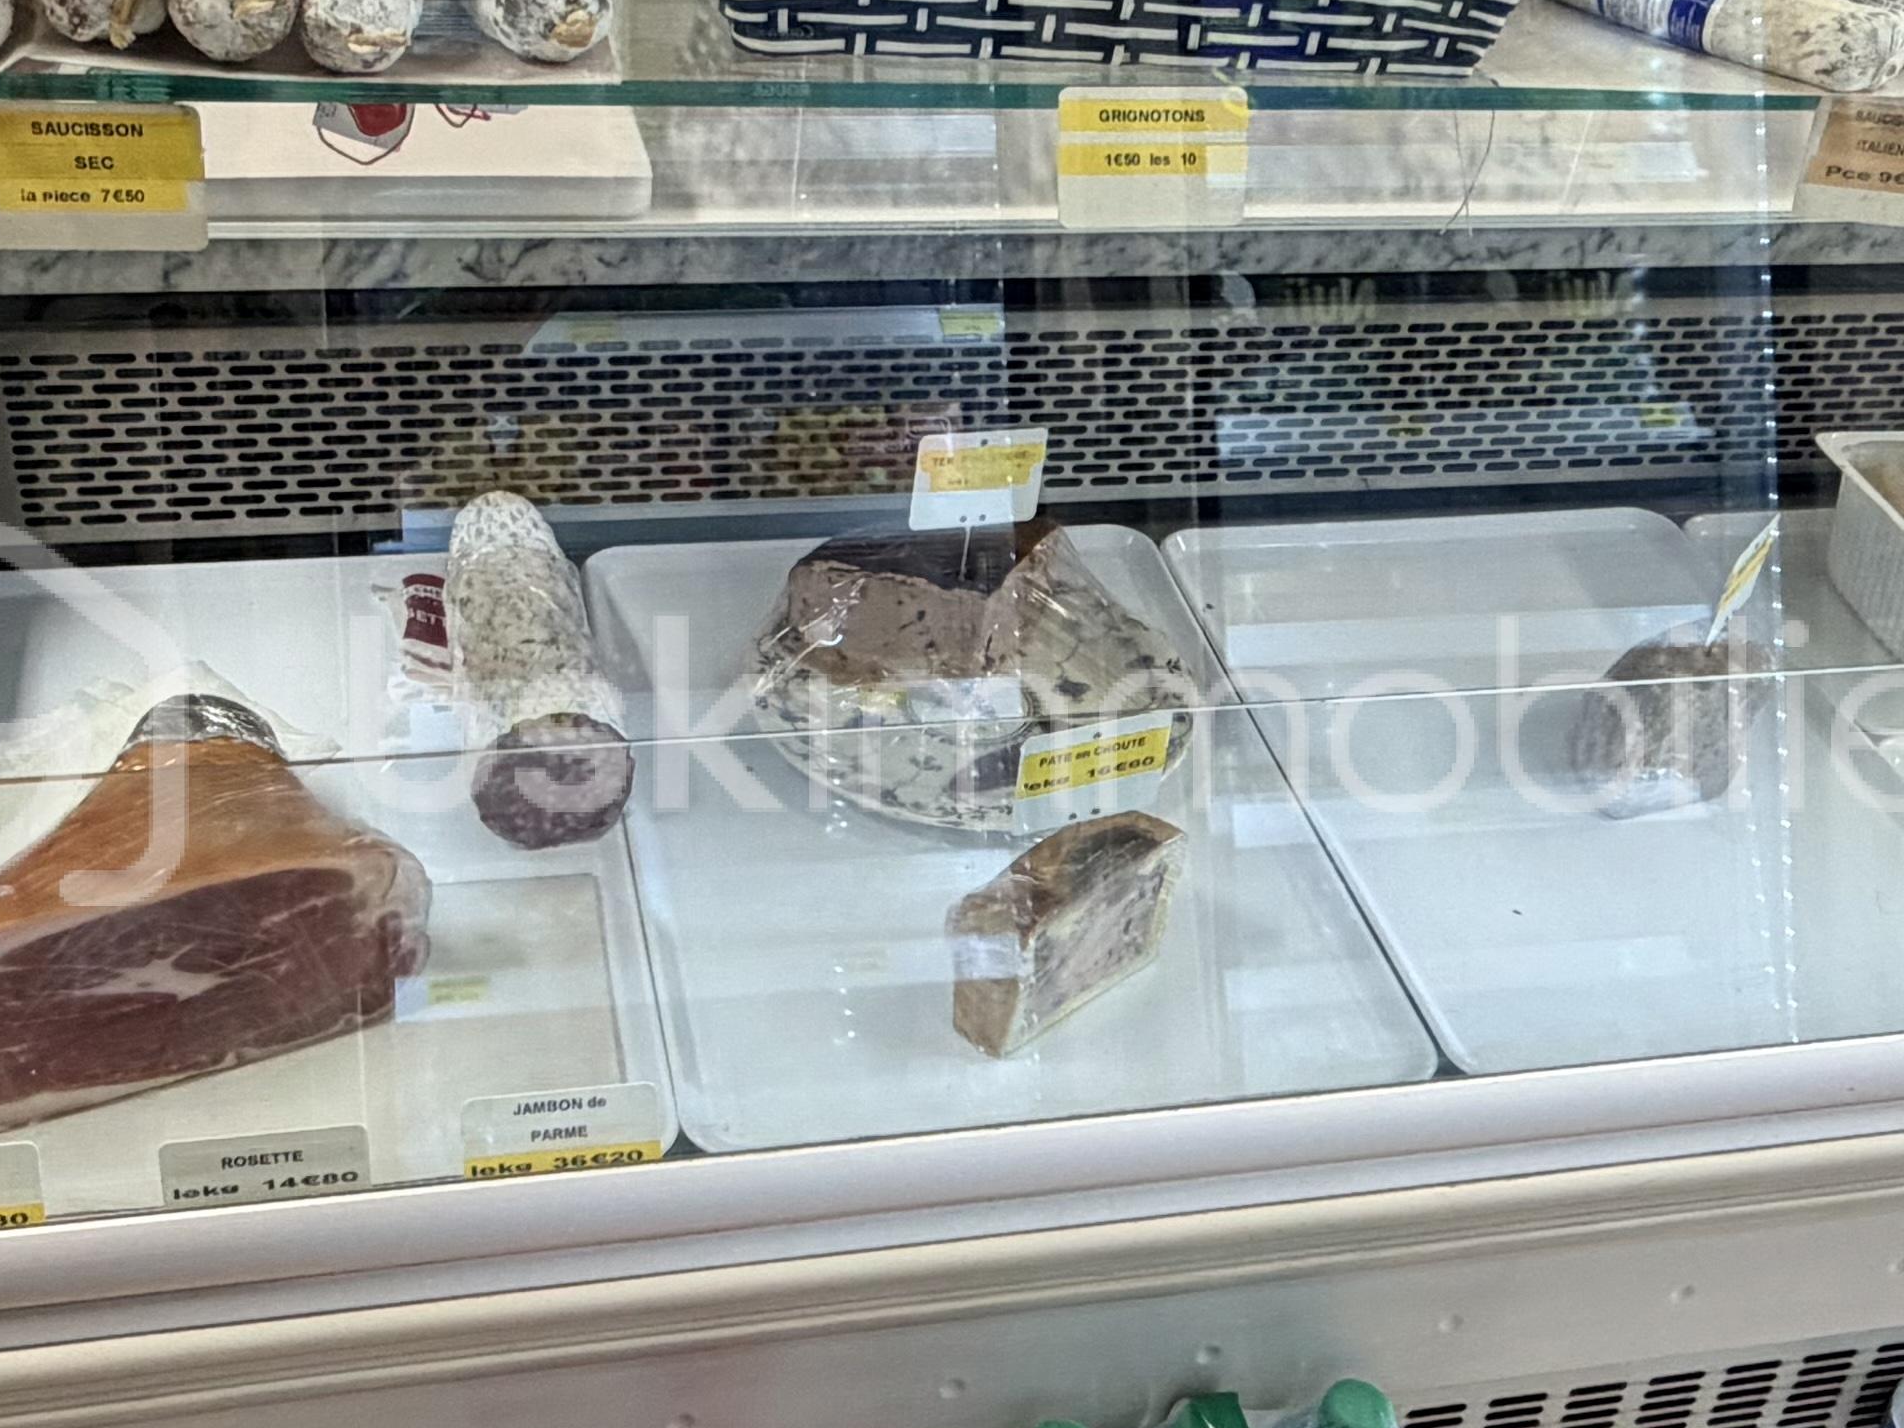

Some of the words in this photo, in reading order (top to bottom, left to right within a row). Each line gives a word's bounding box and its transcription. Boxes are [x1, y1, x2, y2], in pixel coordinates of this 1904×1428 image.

[1099, 109, 1205, 123] GRIGNOTONS
[31, 121, 143, 138] SAUCISSON
[74, 156, 114, 170] SEC
[1105, 153, 1140, 166] 1€50
[1181, 153, 1196, 165] 10
[101, 189, 145, 203] 7€50
[513, 1096, 583, 1118] JAMBON
[588, 1096, 607, 1109] de
[531, 1125, 587, 1143] PARME
[221, 1148, 304, 1170] ROSETTE
